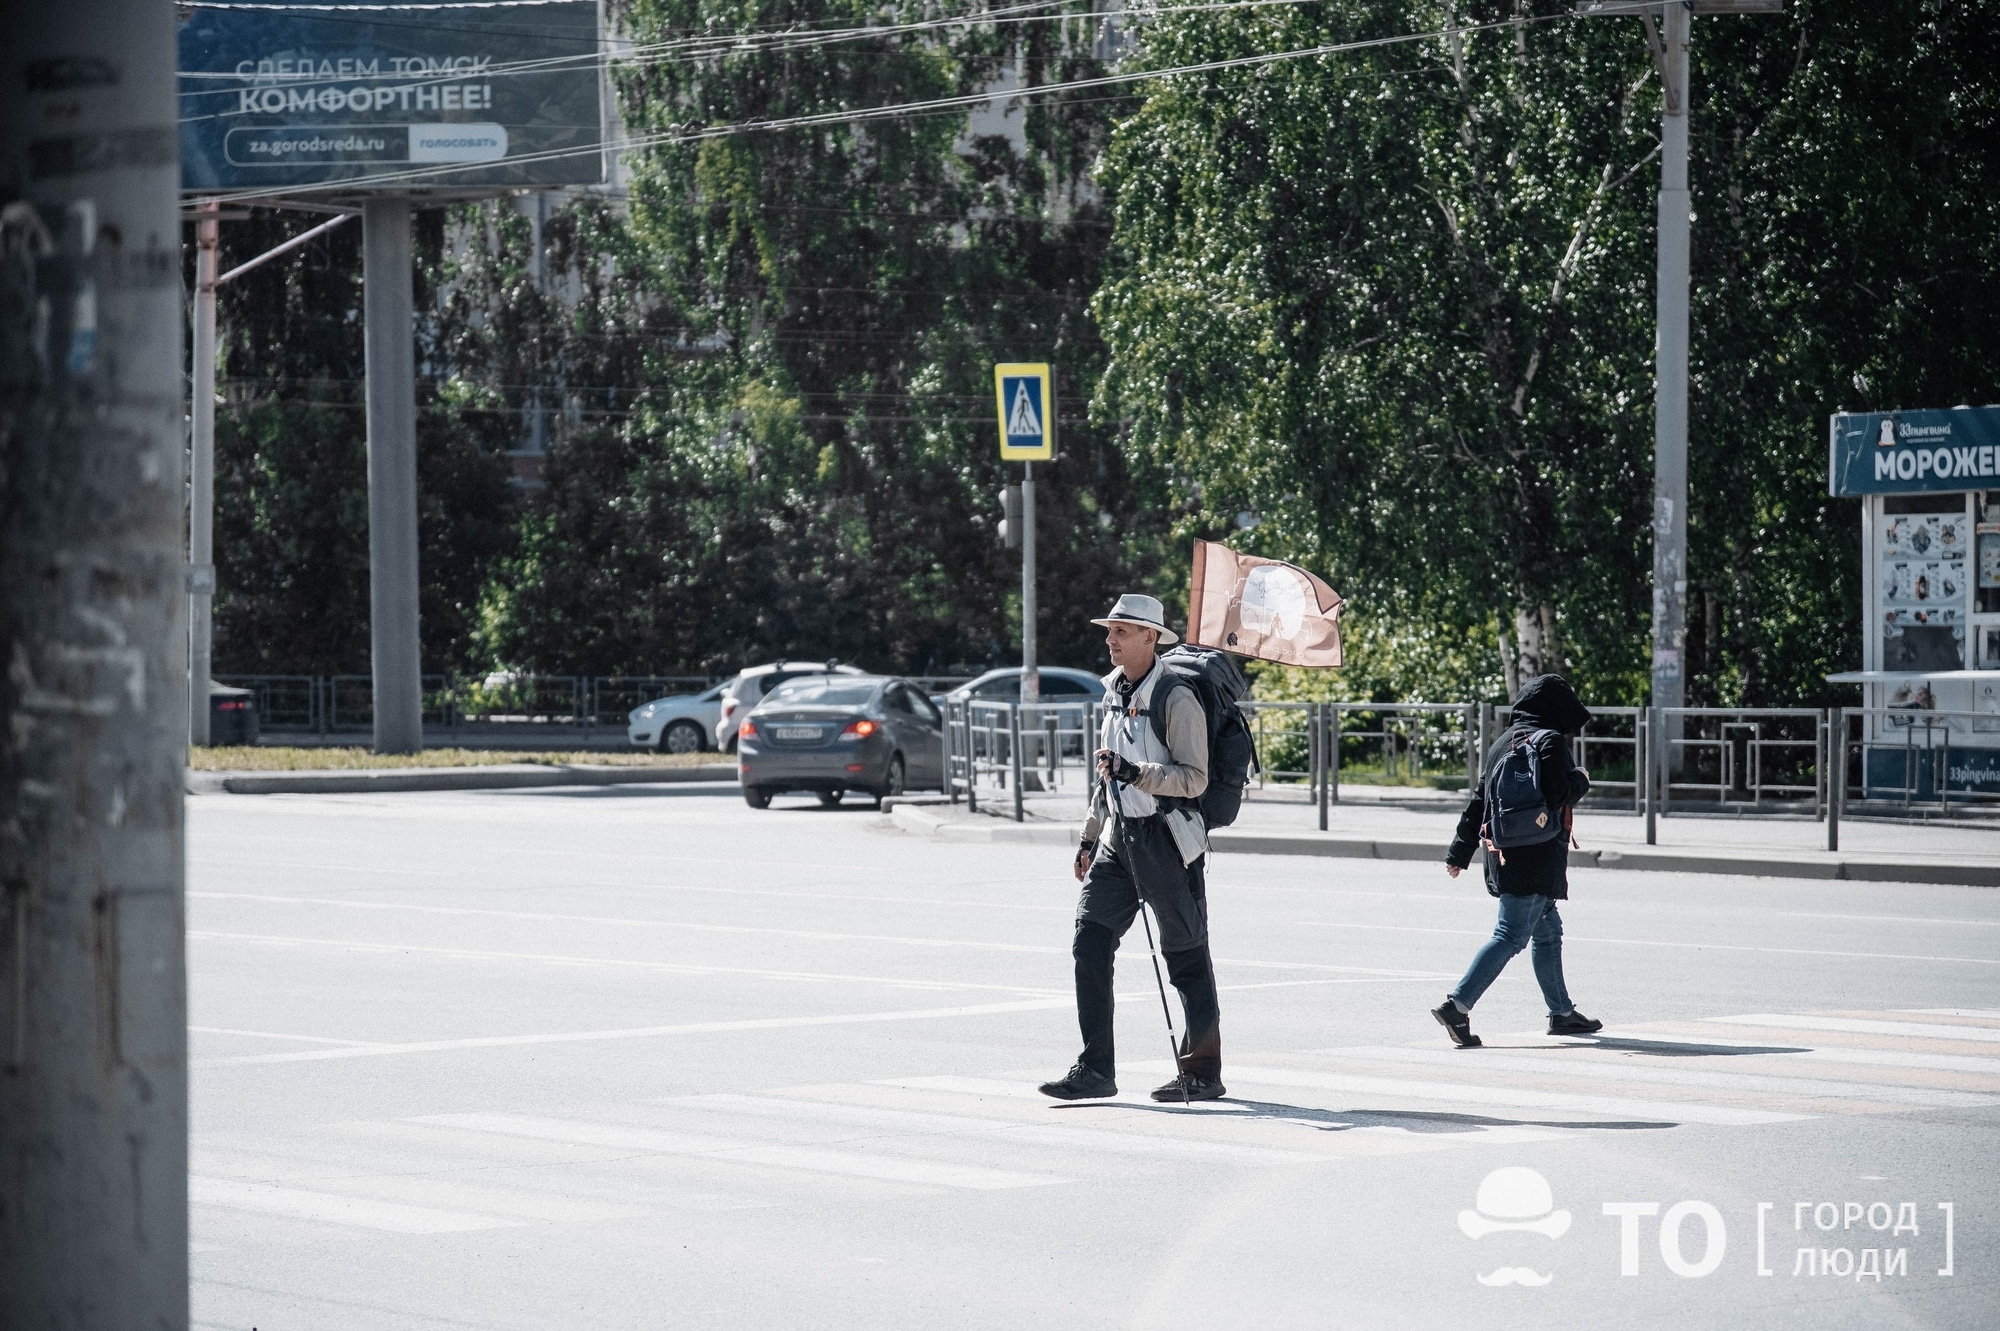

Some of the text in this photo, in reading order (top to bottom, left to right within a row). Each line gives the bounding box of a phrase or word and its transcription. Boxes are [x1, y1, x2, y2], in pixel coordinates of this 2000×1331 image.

[235, 55, 492, 83] СДЕЛАЕМ ТОМСК
[239, 84, 492, 114] КОМФОРТНЕЕ!
[249, 137, 385, 155] za.gorodsreda.ru
[419, 135, 499, 151] голосовать
[1874, 445, 2000, 481] МОРОЖЕ
